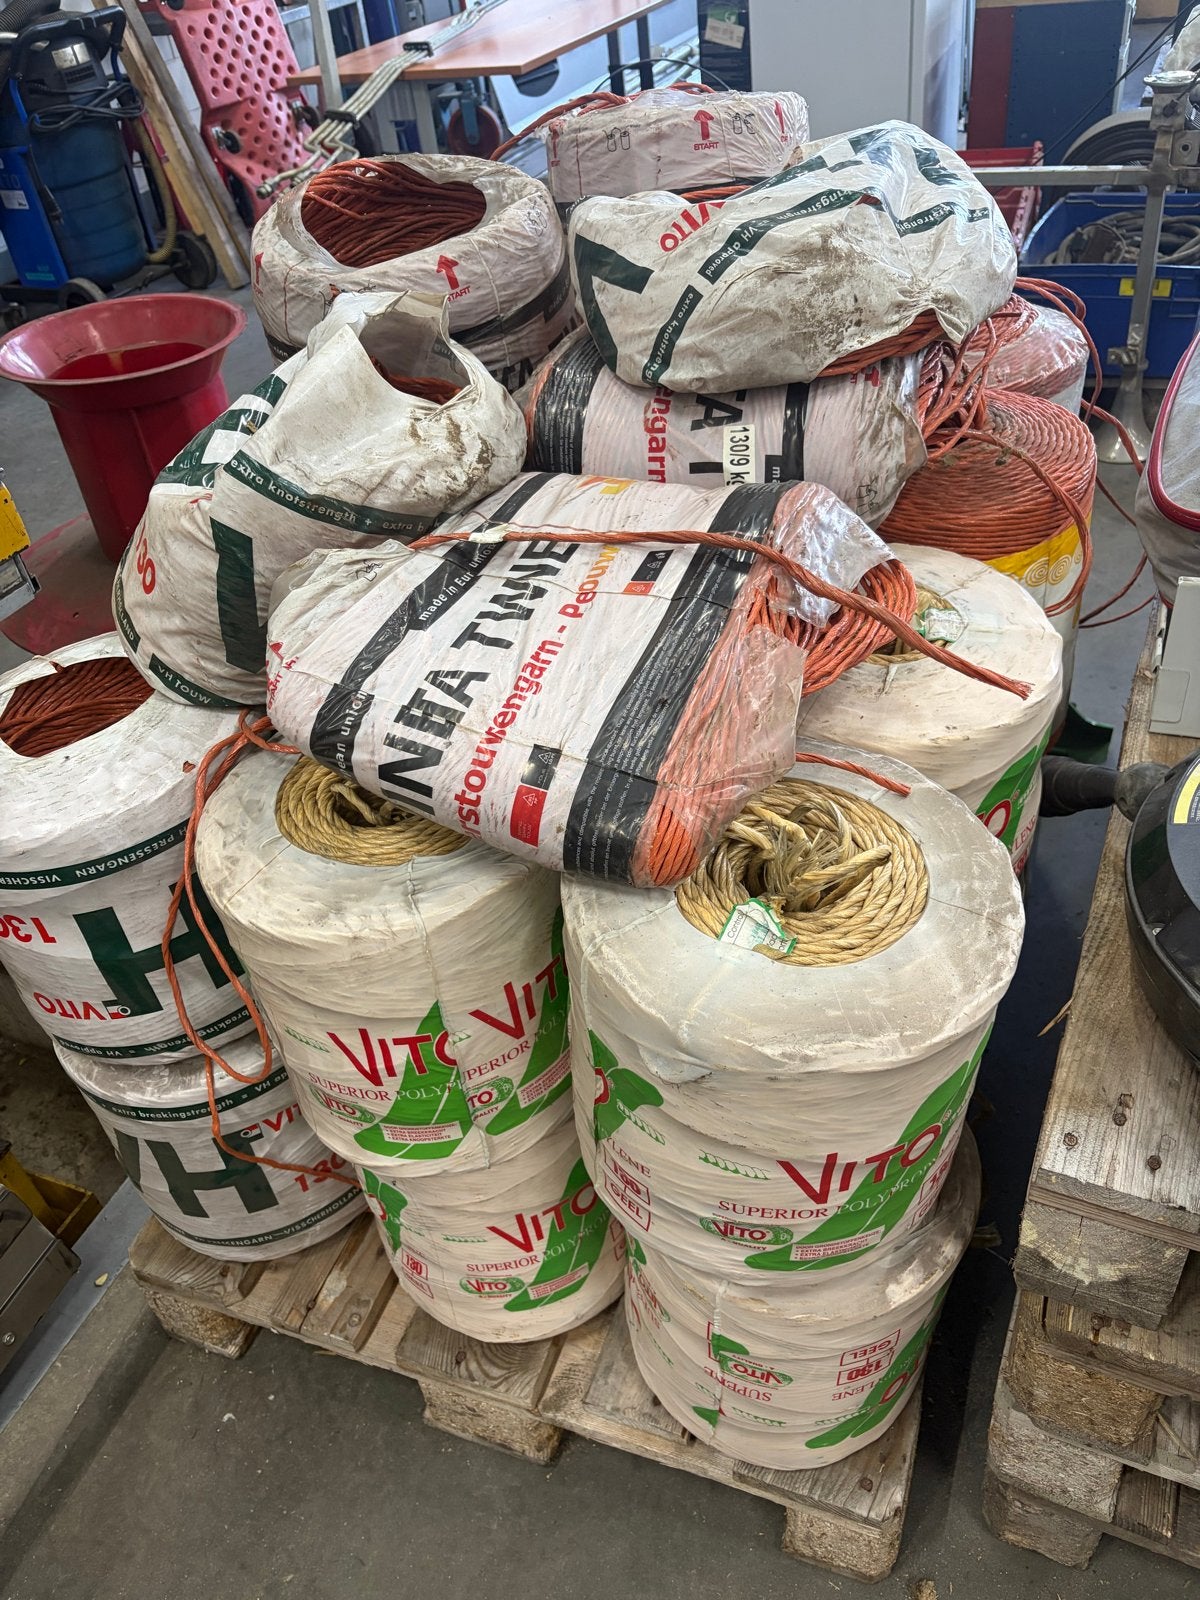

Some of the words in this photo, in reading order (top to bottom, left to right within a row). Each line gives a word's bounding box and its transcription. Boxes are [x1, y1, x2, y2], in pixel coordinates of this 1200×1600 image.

[694, 141, 719, 151] START
[705, 241, 741, 278] approved
[678, 292, 694, 318] extra
[645, 320, 680, 384] knotstreng
[643, 387, 674, 484] engarn
[730, 426, 750, 466] 130/9
[230, 459, 264, 486] extra
[268, 479, 357, 523] knotstrength
[382, 520, 413, 532] extra
[418, 593, 448, 621] made
[445, 585, 459, 596] in
[454, 571, 475, 586] Eur
[158, 664, 173, 681] VH
[173, 675, 212, 705] TOUW
[456, 639, 565, 838] rstouwengarn
[75, 834, 175, 878] PRESSENGARN
[33, 992, 107, 1021] VITO
[468, 956, 568, 1040] VIT
[535, 1009, 567, 1042] POLY
[327, 1028, 458, 1087] VITO
[255, 1081, 272, 1093] VH
[309, 1072, 392, 1101] SUPERIOR
[467, 1090, 494, 1109] TO
[263, 1103, 302, 1132] VIT
[320, 1092, 358, 1117] VITO
[776, 1124, 942, 1205] VITO
[283, 1188, 362, 1236] VISSCHERHOLLAN
[610, 1182, 645, 1220] GEEL
[718, 1200, 829, 1220] SUPERIOR
[486, 1182, 598, 1253] VITO
[712, 1221, 767, 1241] VITO
[466, 1254, 541, 1273] SUPERIOR
[466, 1279, 508, 1293] VITO
[850, 1339, 893, 1359] GEEL
[732, 1363, 783, 1385] VITO
[846, 1359, 884, 1382] 130
[722, 1380, 773, 1402] SUPE
